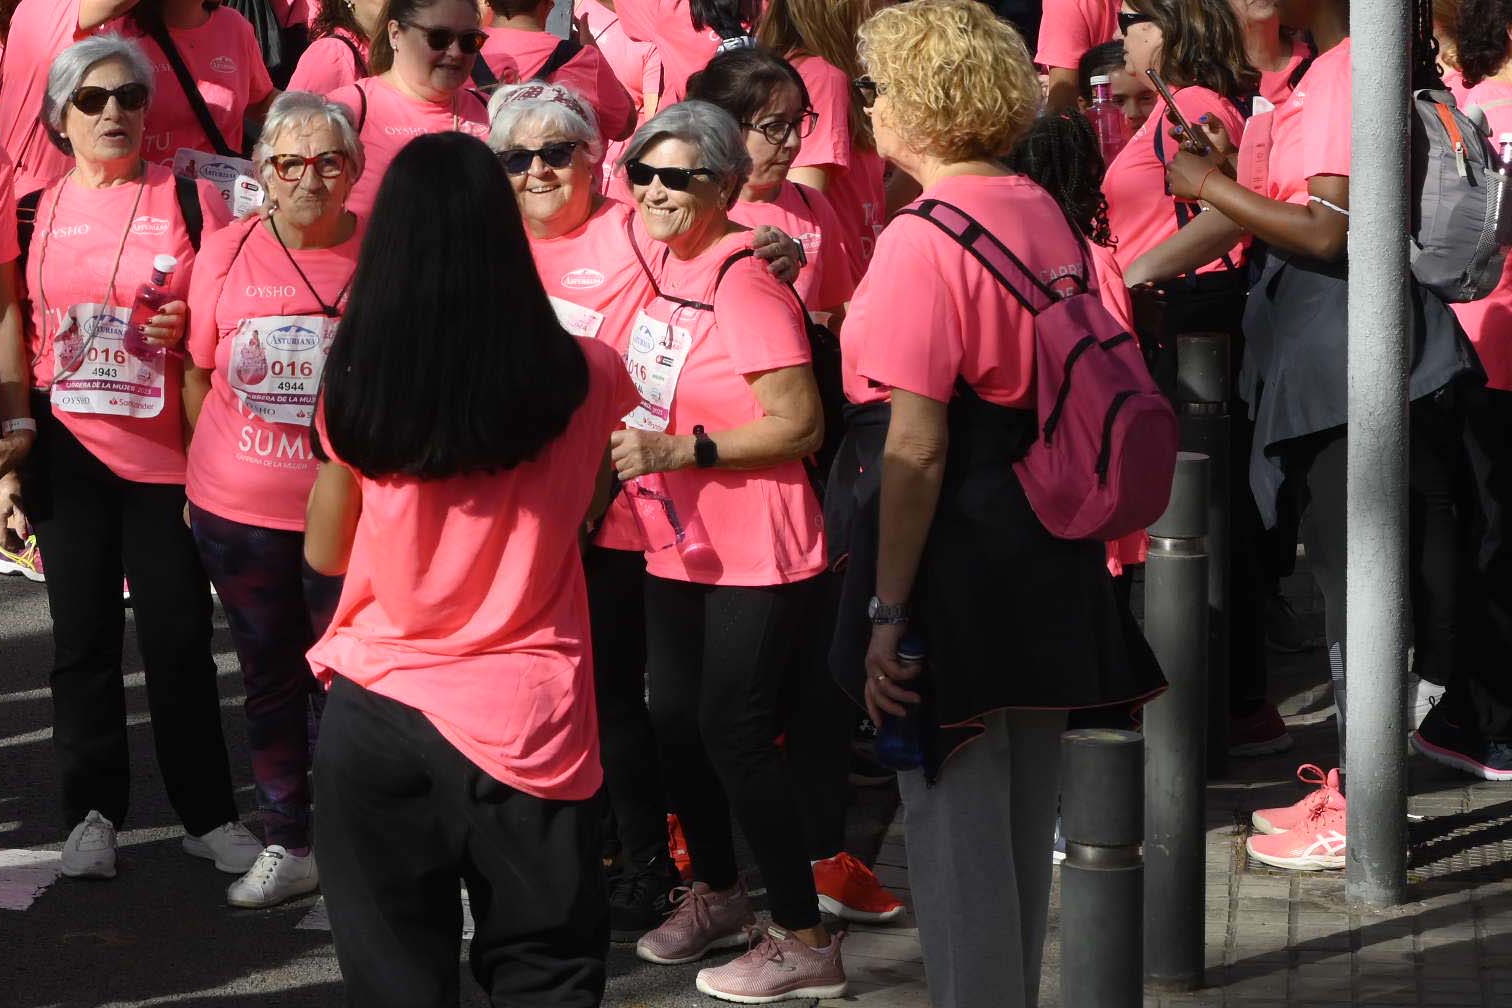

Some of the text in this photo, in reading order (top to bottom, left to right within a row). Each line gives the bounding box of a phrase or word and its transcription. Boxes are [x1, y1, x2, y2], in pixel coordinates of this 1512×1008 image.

[145, 131, 170, 152] TU
[245, 285, 297, 297] OYSHO
[271, 333, 317, 346] ASTURIANA
[87, 347, 126, 364] 016
[92, 367, 118, 378] 4943
[271, 360, 313, 377] 016
[277, 381, 304, 392] 4944
